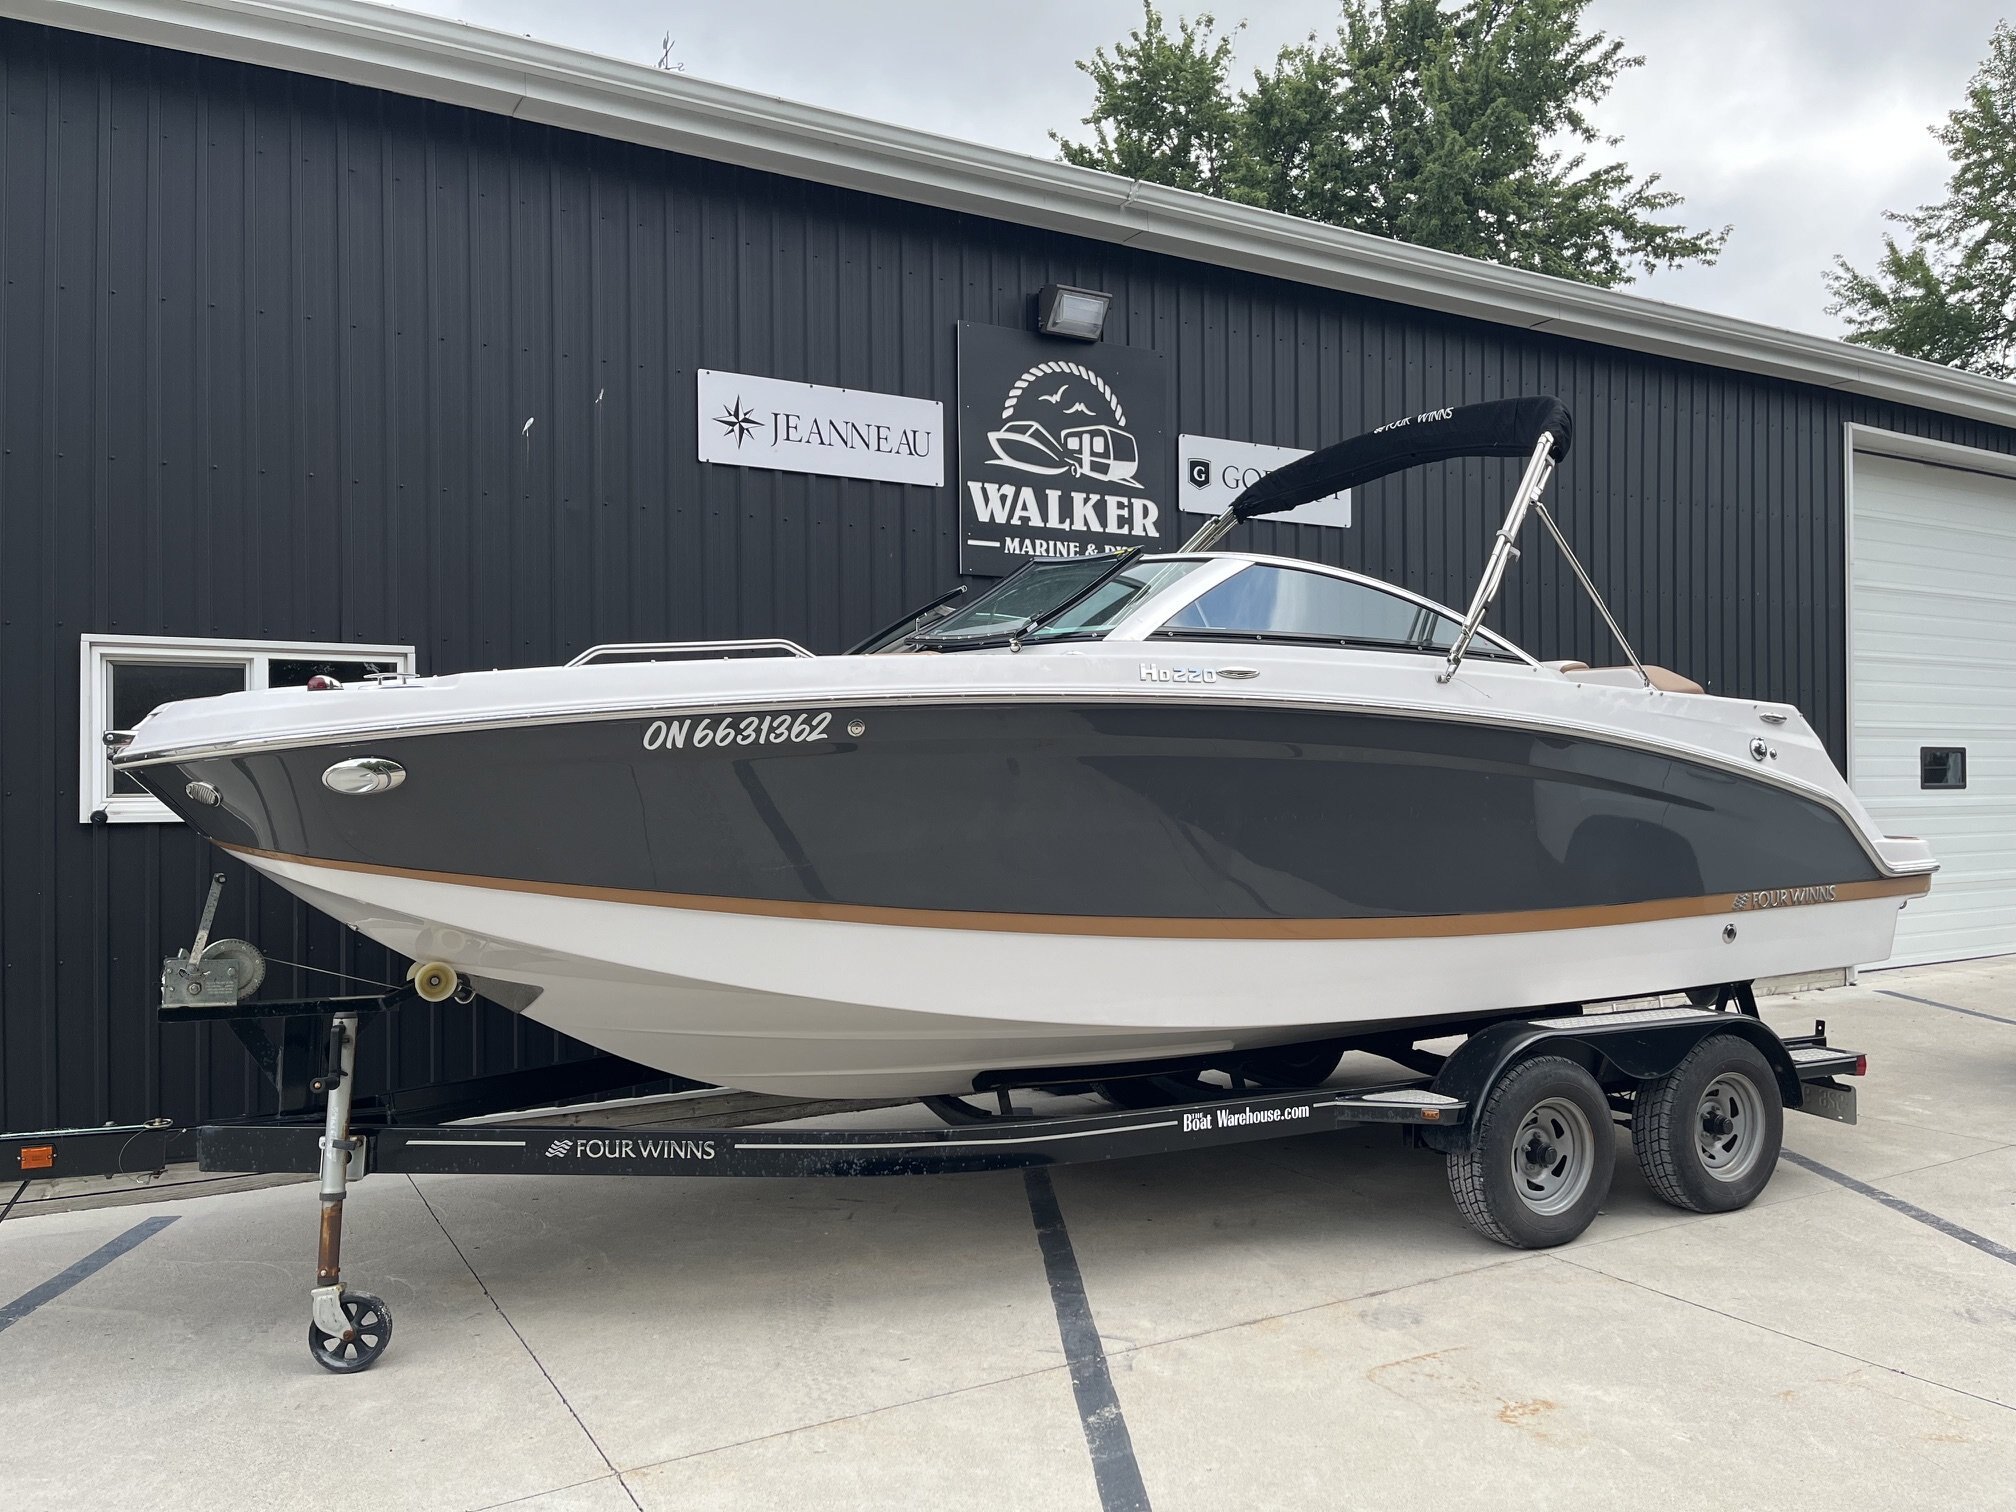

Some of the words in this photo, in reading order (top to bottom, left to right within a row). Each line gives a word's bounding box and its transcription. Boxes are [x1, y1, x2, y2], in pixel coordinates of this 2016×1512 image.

[771, 412, 931, 457] JEANNEAU
[967, 481, 1160, 537] WALKER
[1004, 537, 1080, 557] MARINE
[1085, 543, 1099, 556] &
[1752, 891, 1788, 909] FOUR
[1790, 885, 1836, 904] WINNS
[1183, 1113, 1212, 1132] Boat
[1217, 1106, 1309, 1128] Warehouse.com
[576, 1140, 637, 1158] FOUR
[638, 1140, 715, 1159] WINNS
